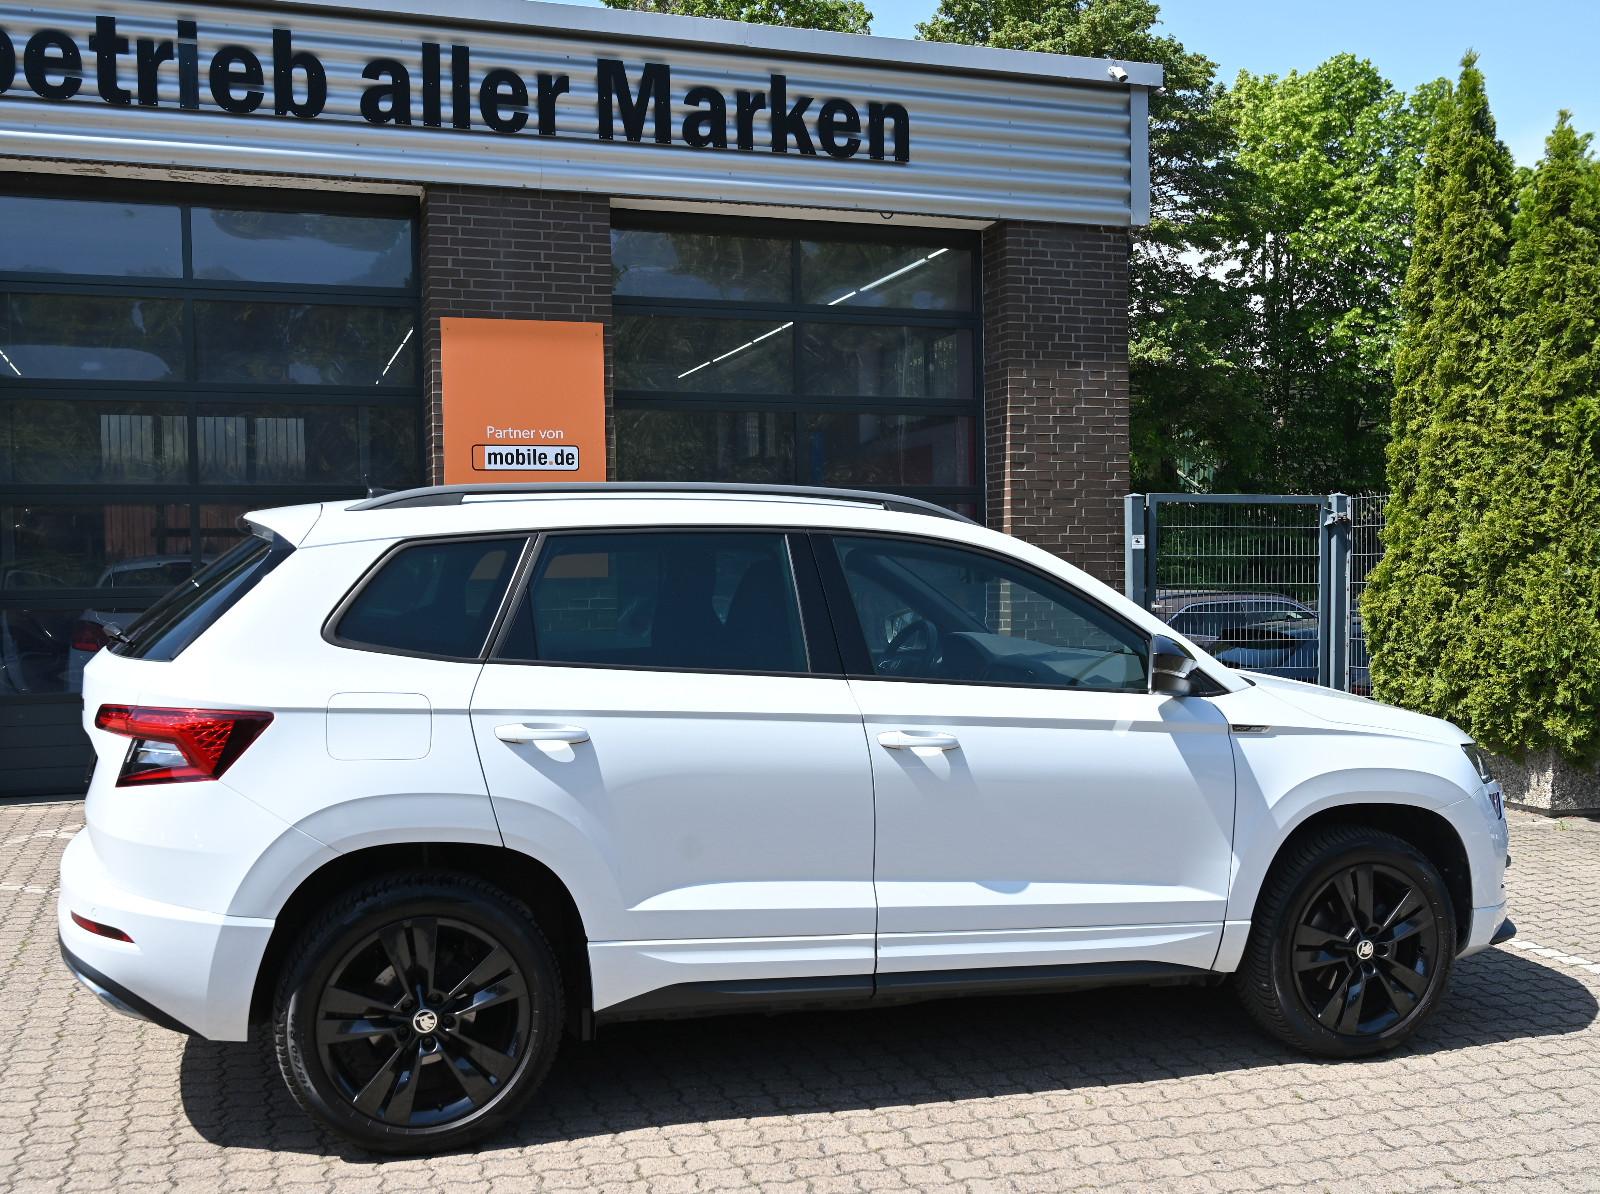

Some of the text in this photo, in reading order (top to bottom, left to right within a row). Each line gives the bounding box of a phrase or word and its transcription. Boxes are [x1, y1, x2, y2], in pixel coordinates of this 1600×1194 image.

[0, 15, 910, 163] etrieb aller Marken
[486, 425, 564, 439] Partner von
[487, 448, 575, 466] mobile.de
